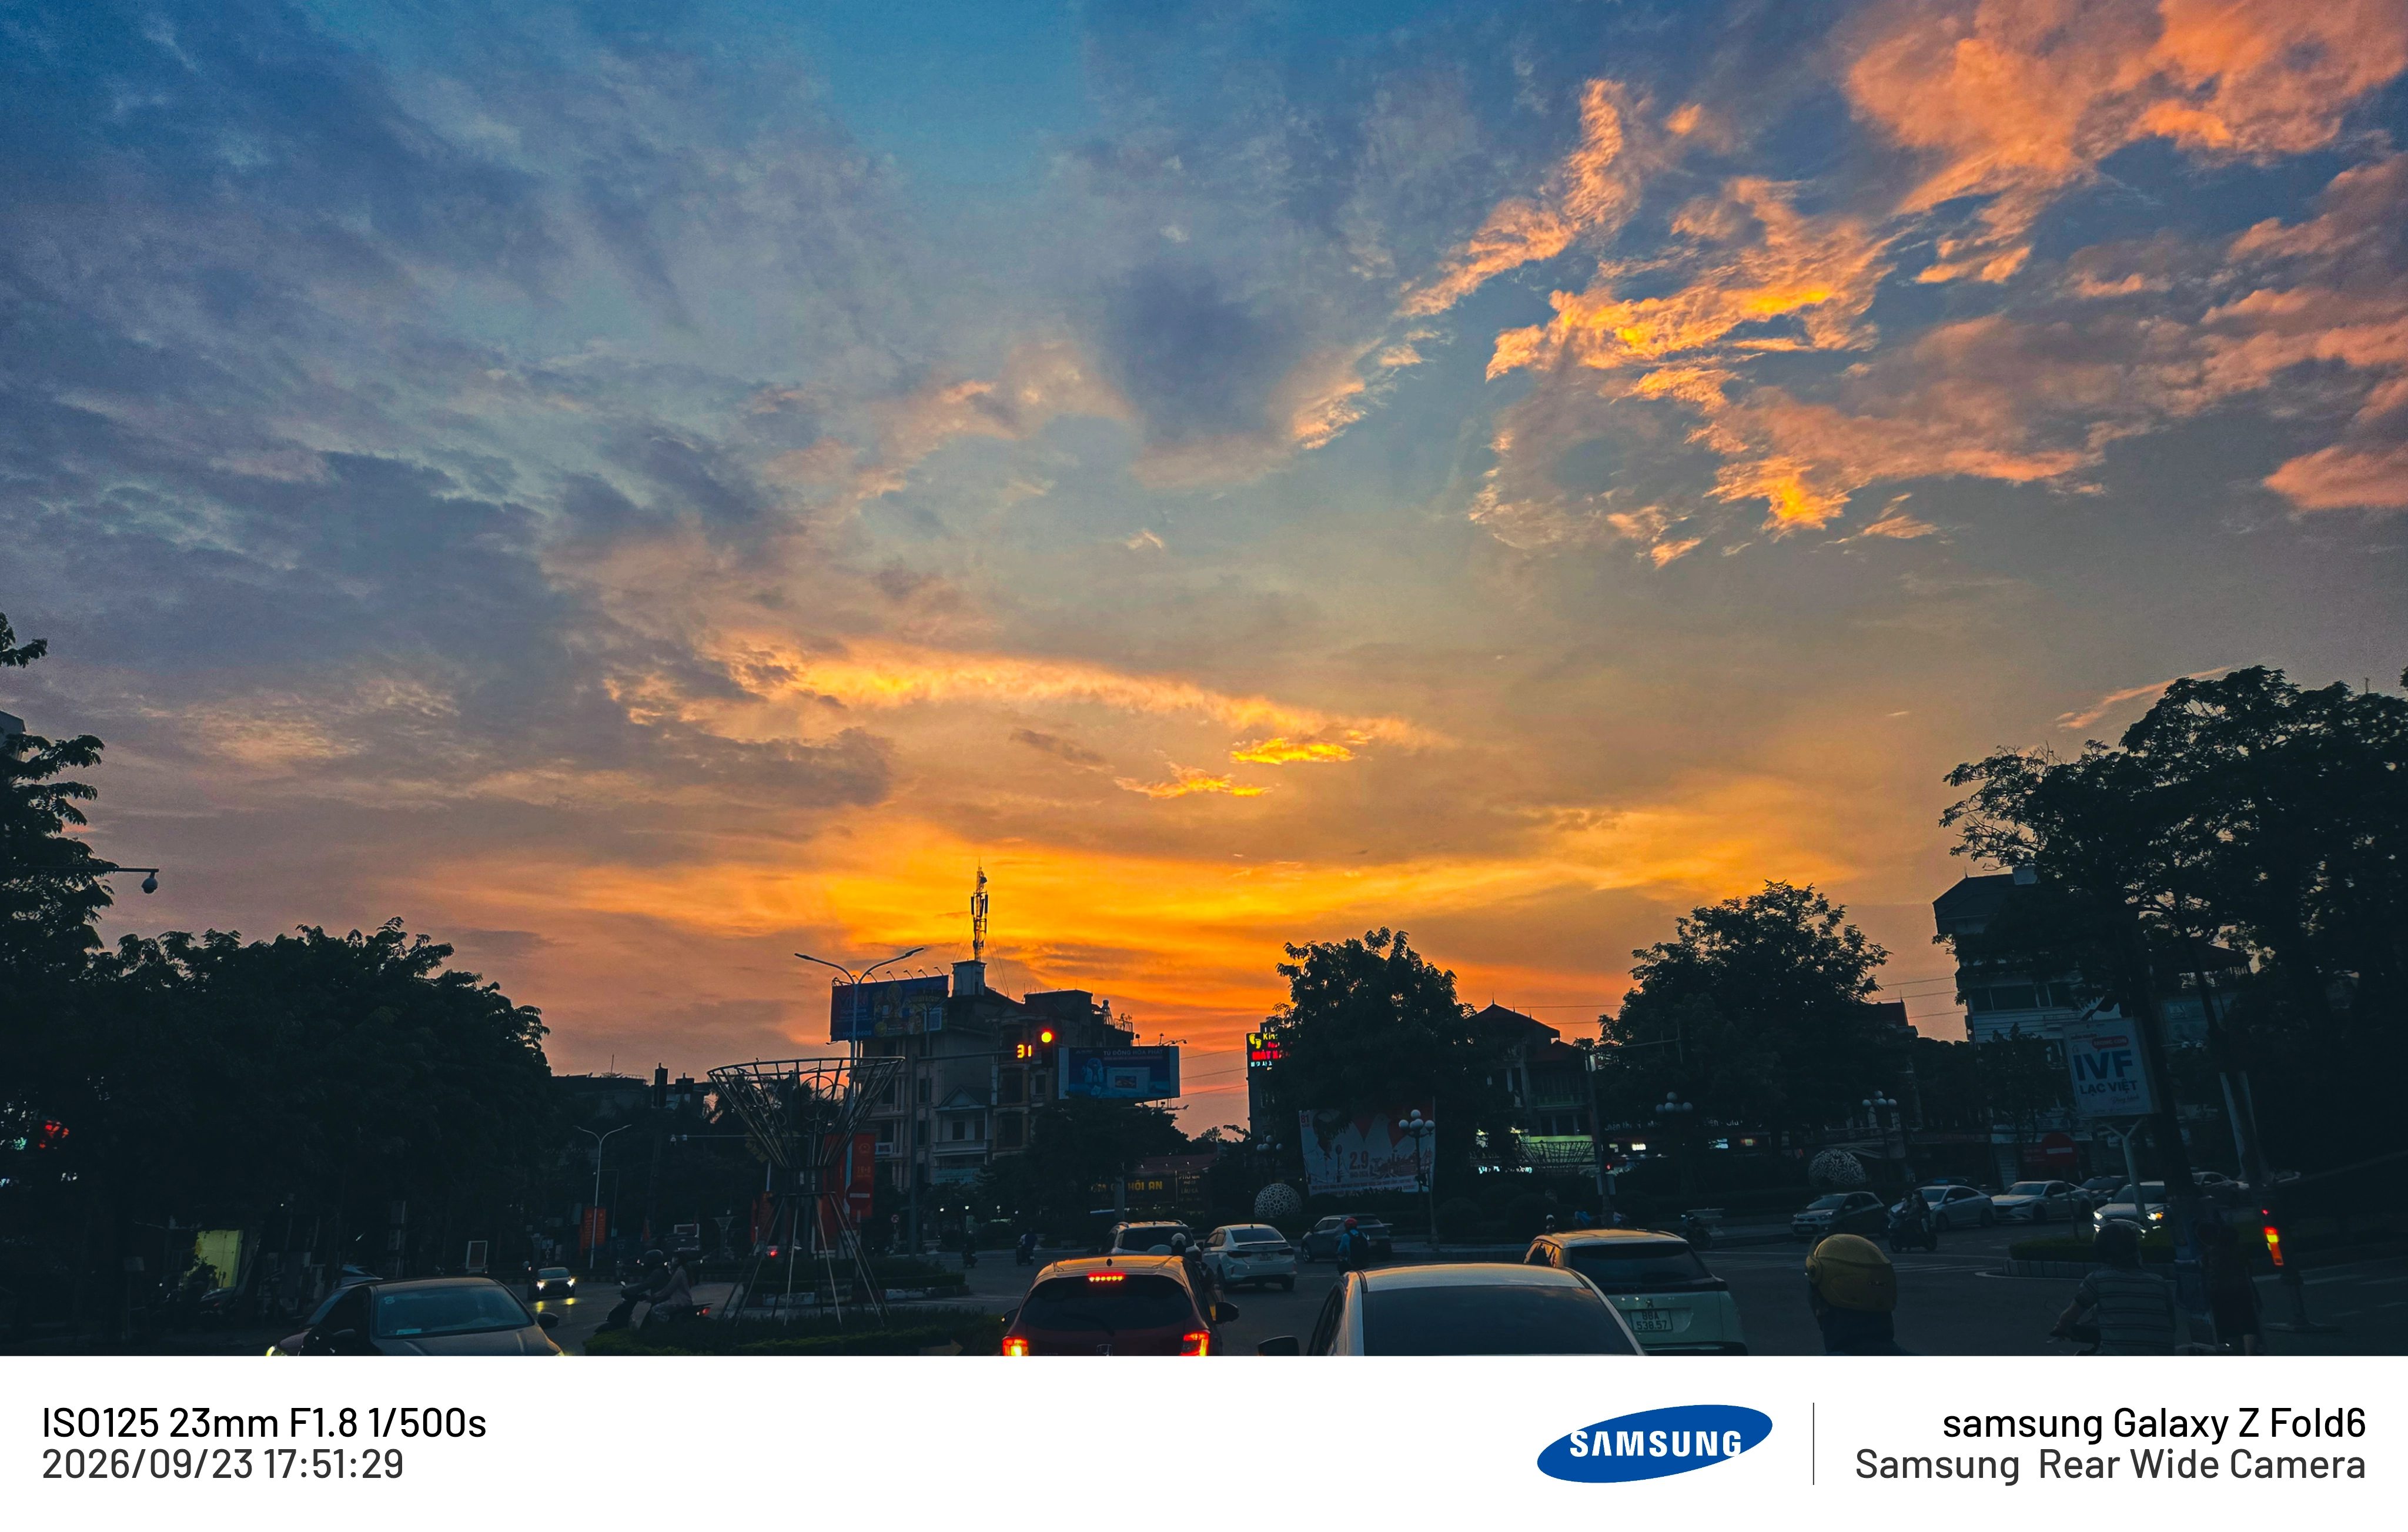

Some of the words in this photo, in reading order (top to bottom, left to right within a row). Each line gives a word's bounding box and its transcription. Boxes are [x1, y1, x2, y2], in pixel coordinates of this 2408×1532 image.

[1016, 1044, 1032, 1058] 31
[2073, 1050, 2133, 1081] IVF
[2079, 1083, 2106, 1096] LẠC
[2108, 1078, 2137, 1093] VIỆT
[1349, 1150, 1369, 1169] 2.9
[1128, 1179, 1145, 1191] HỘI
[1148, 1181, 1163, 1190] AN
[1642, 1311, 1660, 1320] 88A
[1637, 1320, 1667, 1330] 538.57
